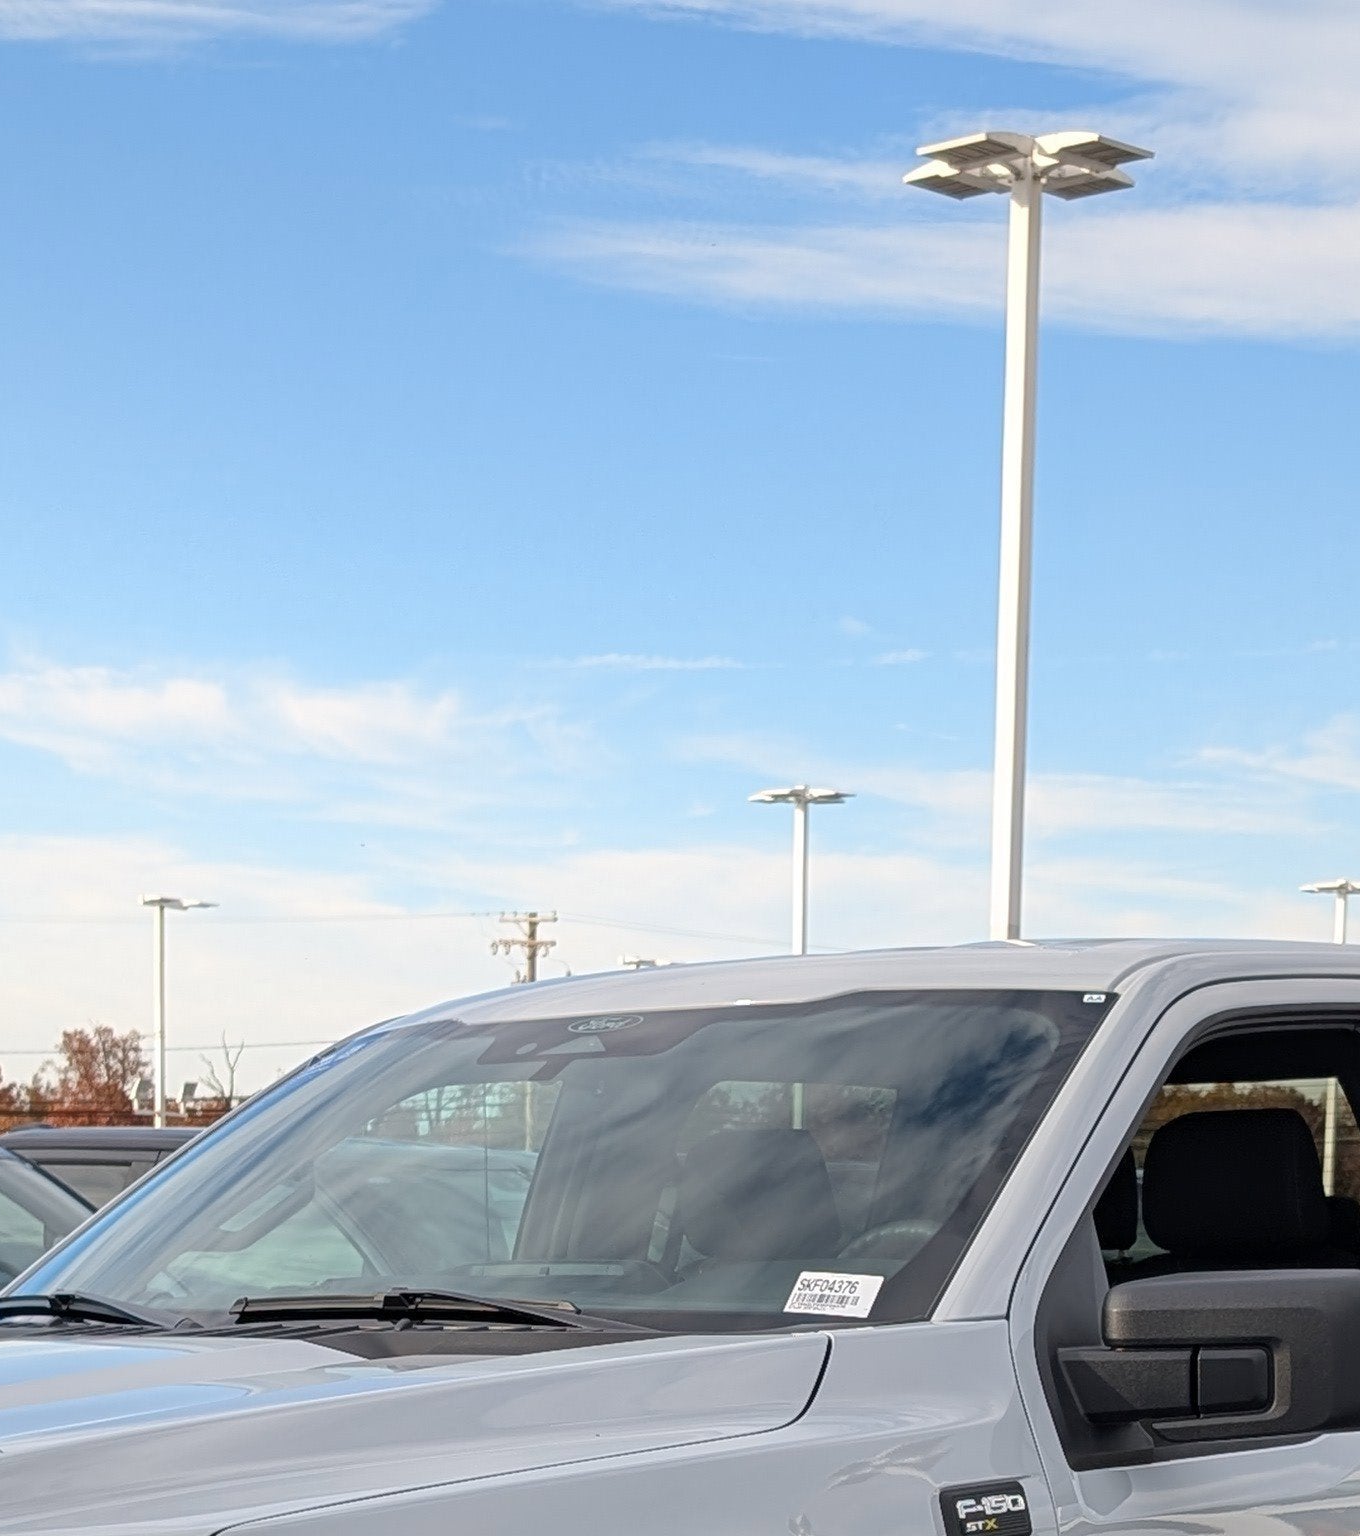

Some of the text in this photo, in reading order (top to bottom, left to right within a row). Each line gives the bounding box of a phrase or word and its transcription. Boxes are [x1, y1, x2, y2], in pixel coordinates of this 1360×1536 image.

[797, 1278, 860, 1295] SKF04376
[955, 1493, 1026, 1519] F-150
[965, 1518, 999, 1533] STX
